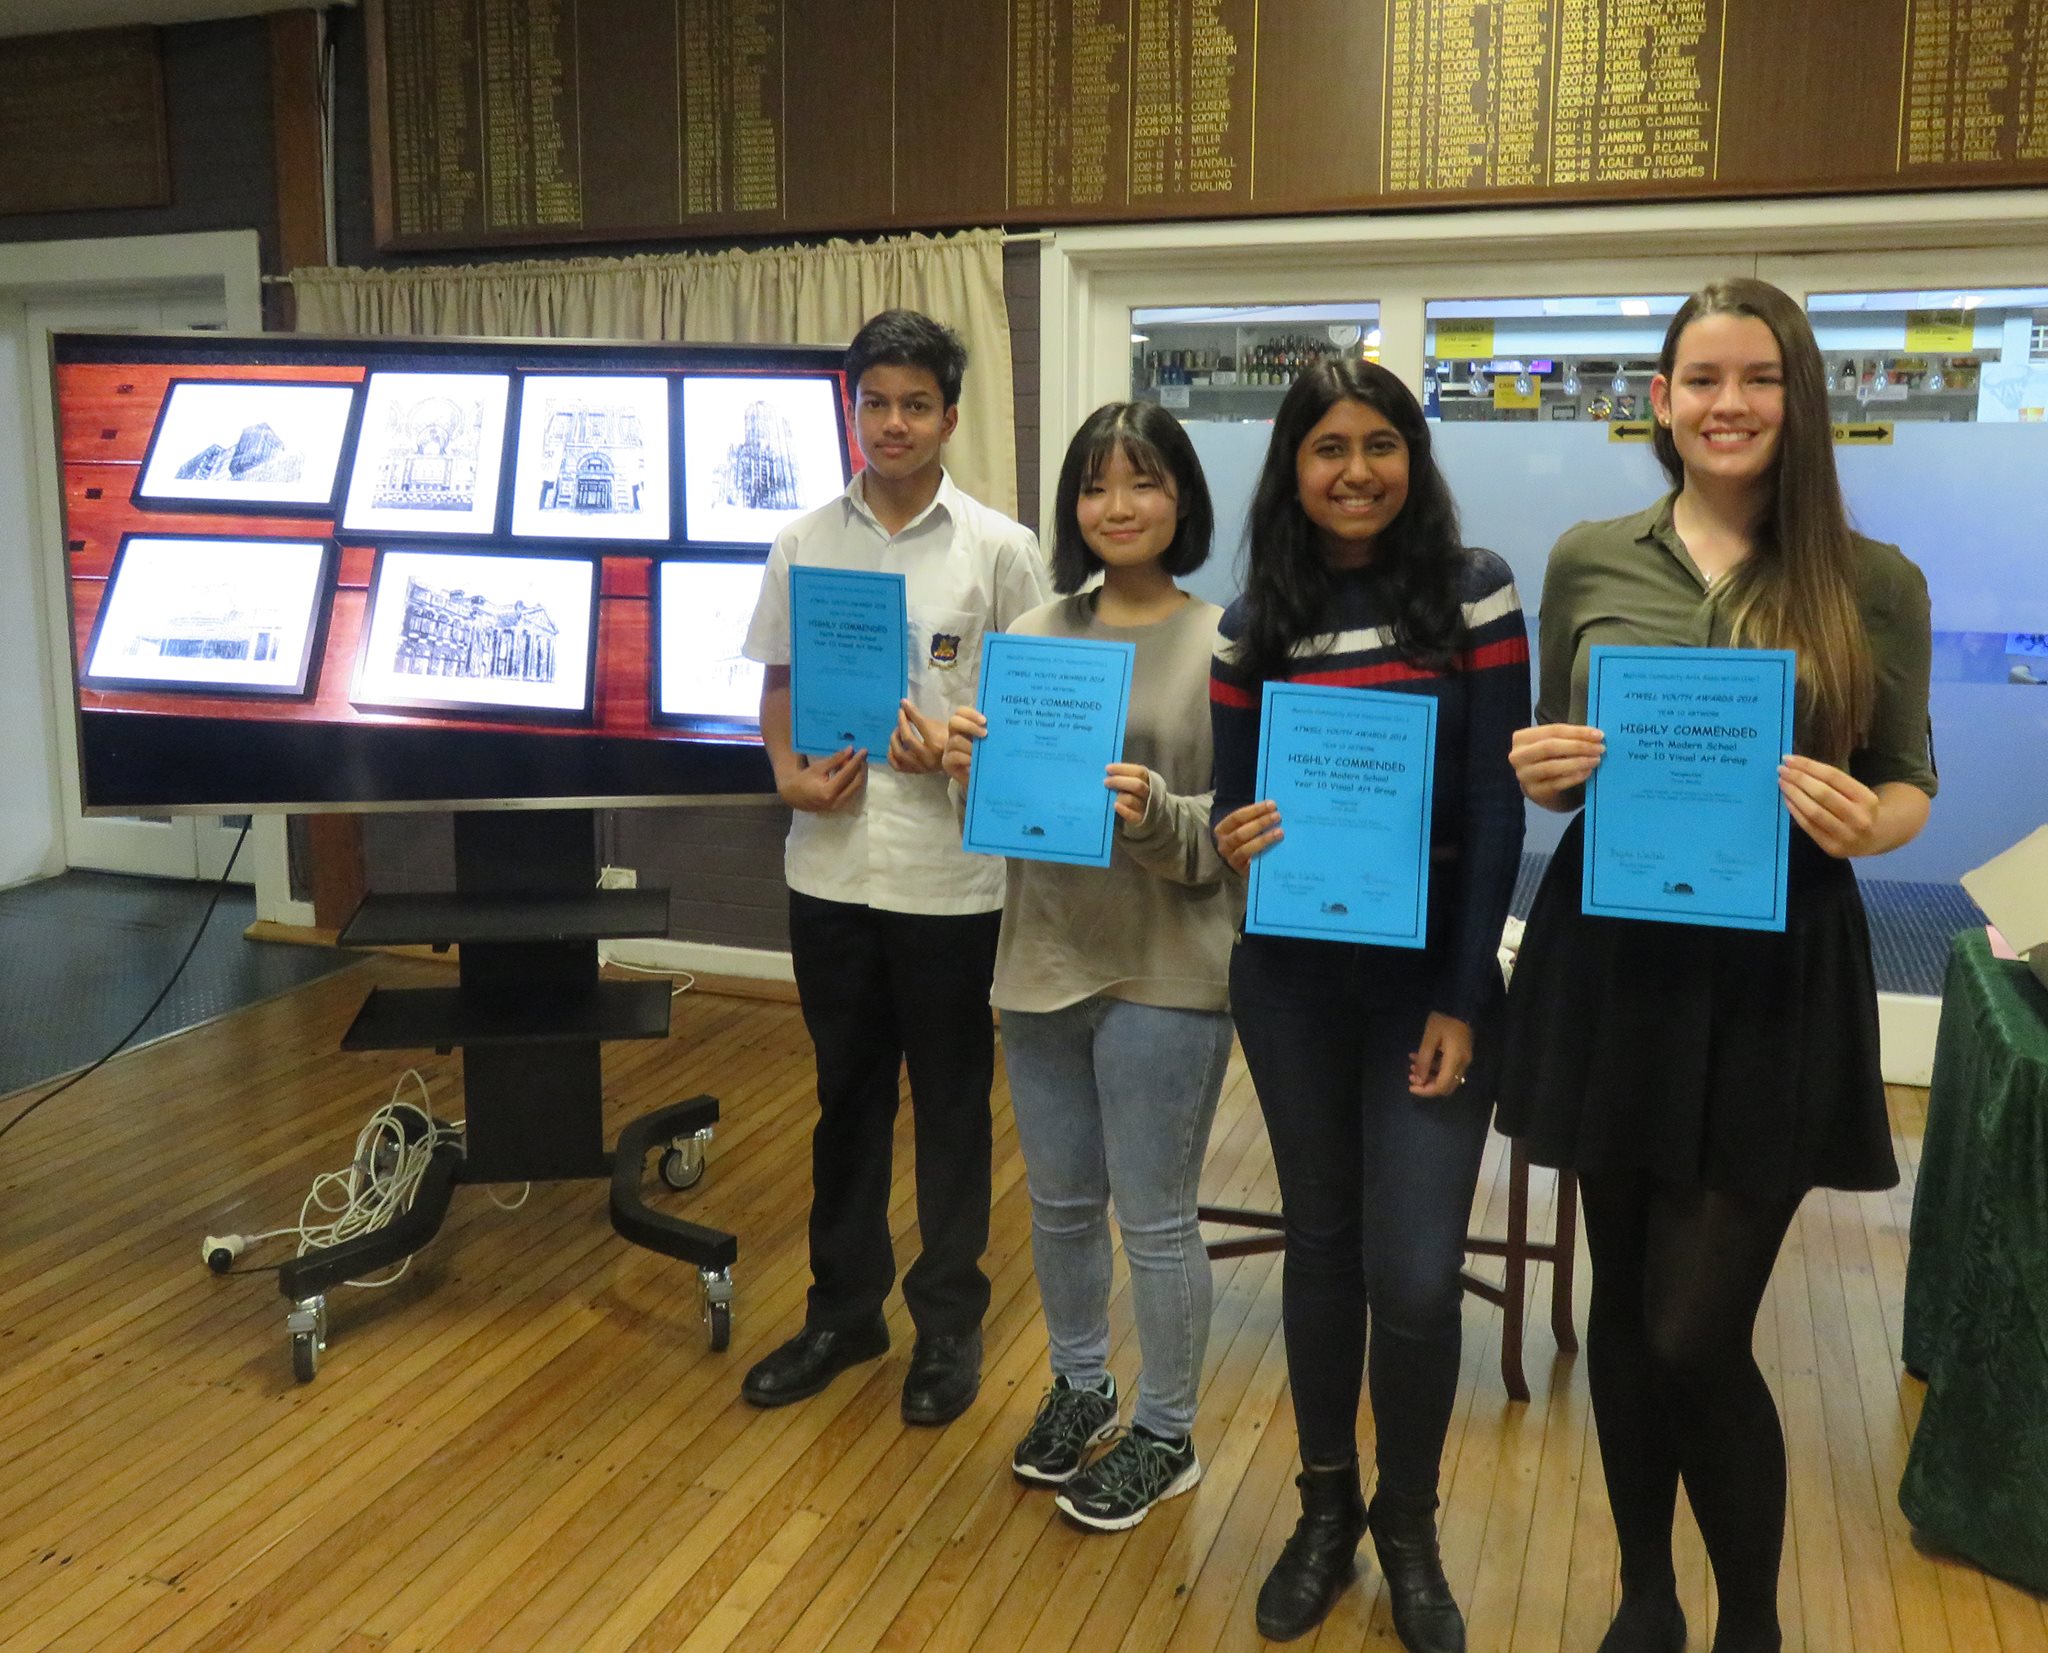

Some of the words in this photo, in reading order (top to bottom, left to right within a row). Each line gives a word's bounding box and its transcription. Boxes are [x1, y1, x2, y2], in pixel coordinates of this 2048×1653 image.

[1617, 4, 1663, 17] KENNEDY
[1676, 1, 1706, 12] SMITH
[1681, 13, 1706, 23] HALL
[1443, 39, 1473, 50] THORN
[1191, 112, 1227, 123] COOPER
[1191, 134, 1222, 145] MILLER
[1190, 156, 1237, 169] RANDALL
[1190, 169, 1231, 180] IRELAND
[1190, 180, 1233, 192] CARLINO
[1000, 694, 1037, 706] HIGHLY
[1040, 697, 1102, 712] COMMENDED
[1695, 693, 1734, 703] AWARDS
[1620, 722, 1669, 735] HIGHLY
[1673, 724, 1758, 739] COMMENDED
[1638, 739, 1664, 748] Perth
[1667, 740, 1703, 750] Modern
[1706, 742, 1738, 752] School
[1288, 753, 1331, 766] HIGHLY
[1335, 757, 1406, 773] COMMENDED
[1627, 751, 1650, 761] Year
[1653, 752, 1665, 761] 10
[1668, 752, 1697, 763] Visual
[1700, 754, 1716, 763] Art
[1720, 754, 1748, 767] Group
[1304, 768, 1327, 777] Perth
[1329, 770, 1360, 781] Modern
[1363, 773, 1389, 783] School
[1294, 779, 1312, 788] Year
[1317, 780, 1327, 789] 10
[1330, 782, 1354, 792] Visual
[1357, 784, 1371, 793] Art
